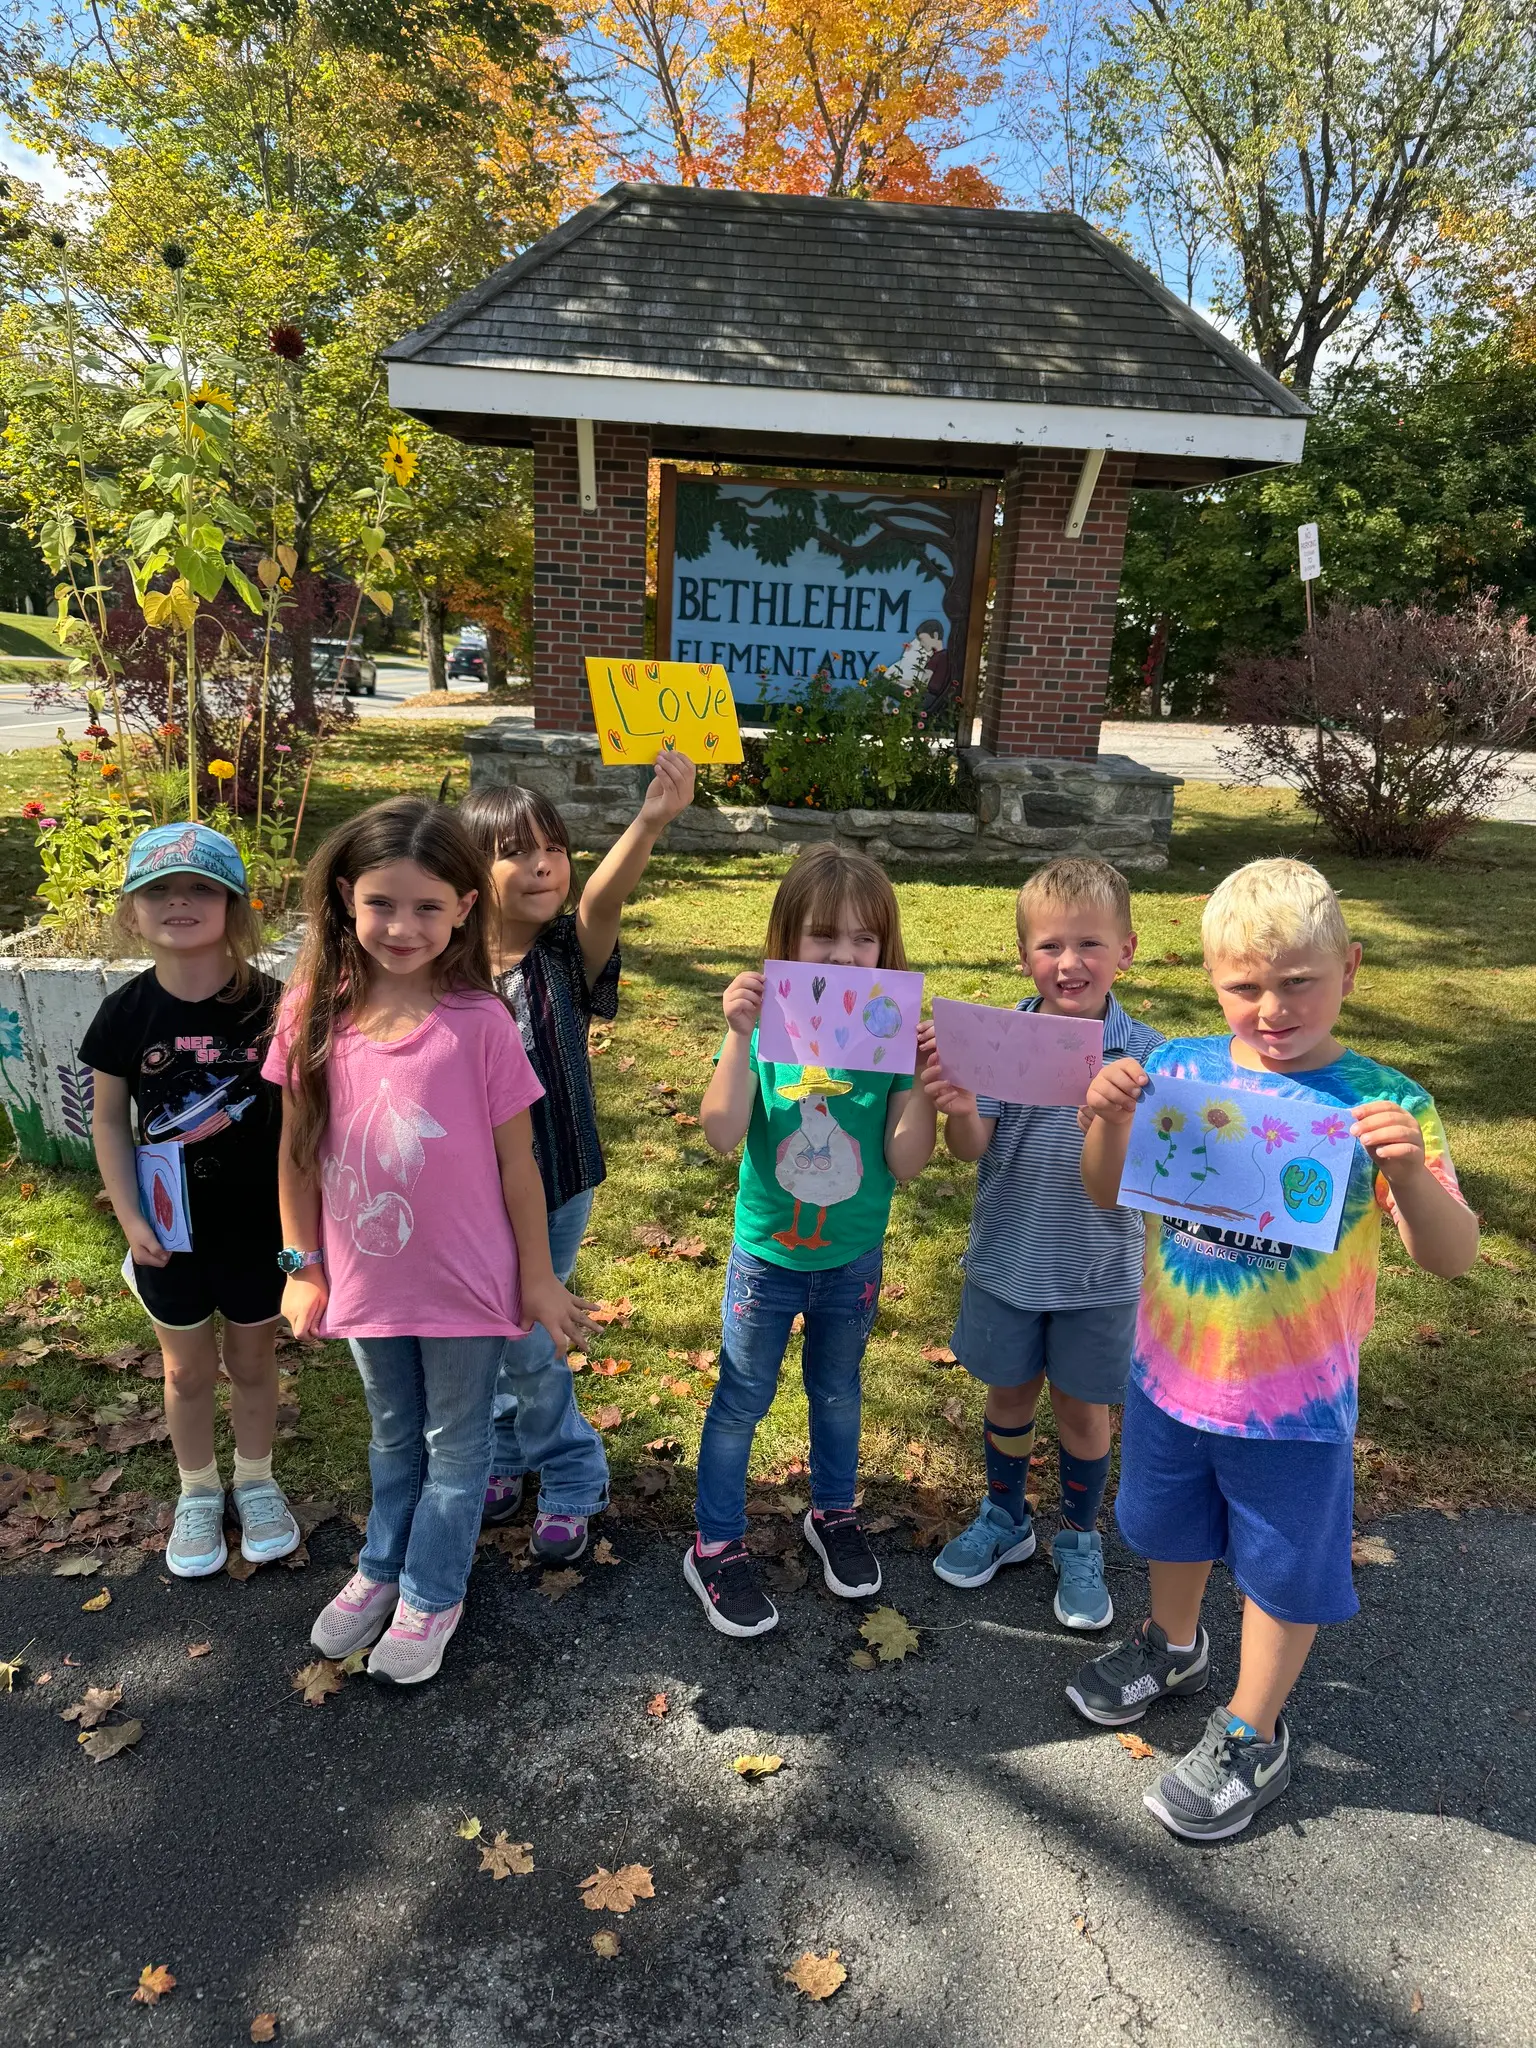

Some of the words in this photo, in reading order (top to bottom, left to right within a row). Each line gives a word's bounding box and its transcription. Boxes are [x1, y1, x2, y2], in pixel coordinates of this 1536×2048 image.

[677, 577, 912, 634] BETHLEHEM
[677, 640, 880, 680] ELEMENTARY
[607, 666, 729, 736] Love
[1174, 1232, 1191, 1248] ON
[1196, 1241, 1238, 1262] LAKE
[1247, 1255, 1287, 1272] TIME
[1218, 1228, 1282, 1255] YORK
